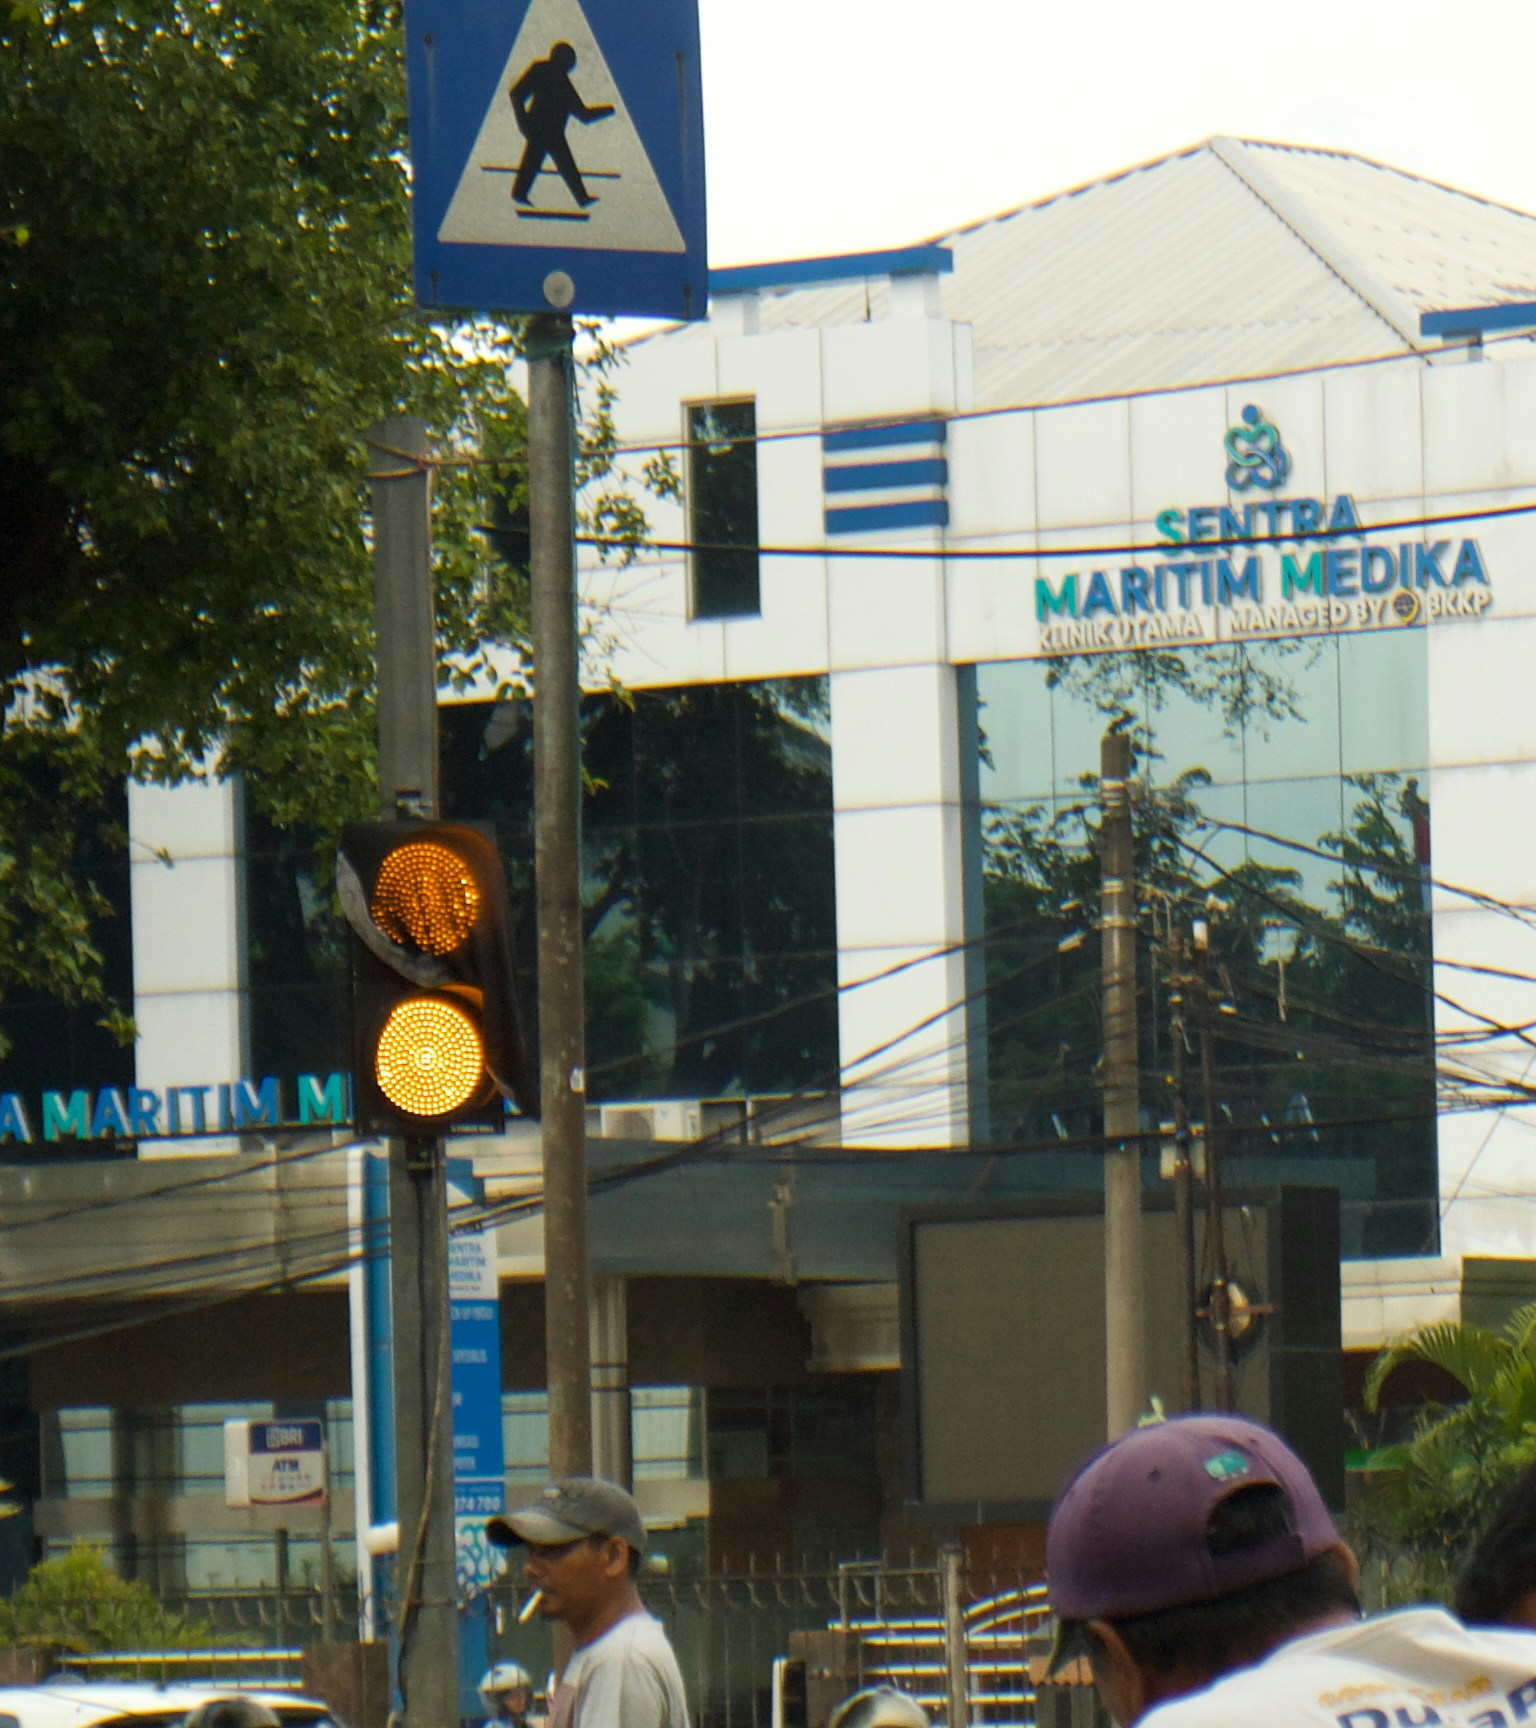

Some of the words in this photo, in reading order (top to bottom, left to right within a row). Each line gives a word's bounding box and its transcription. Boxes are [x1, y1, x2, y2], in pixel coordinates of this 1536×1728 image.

[1156, 494, 1362, 557] SENTRA
[1035, 556, 1262, 623] MARITIM
[1281, 537, 1491, 599] MEDIKA
[1039, 620, 1114, 651] KLINIK
[1118, 611, 1203, 644] UTAMA
[1229, 596, 1350, 633] MANAGED
[1352, 596, 1386, 622] BY
[41, 1077, 281, 1142] MARITIM
